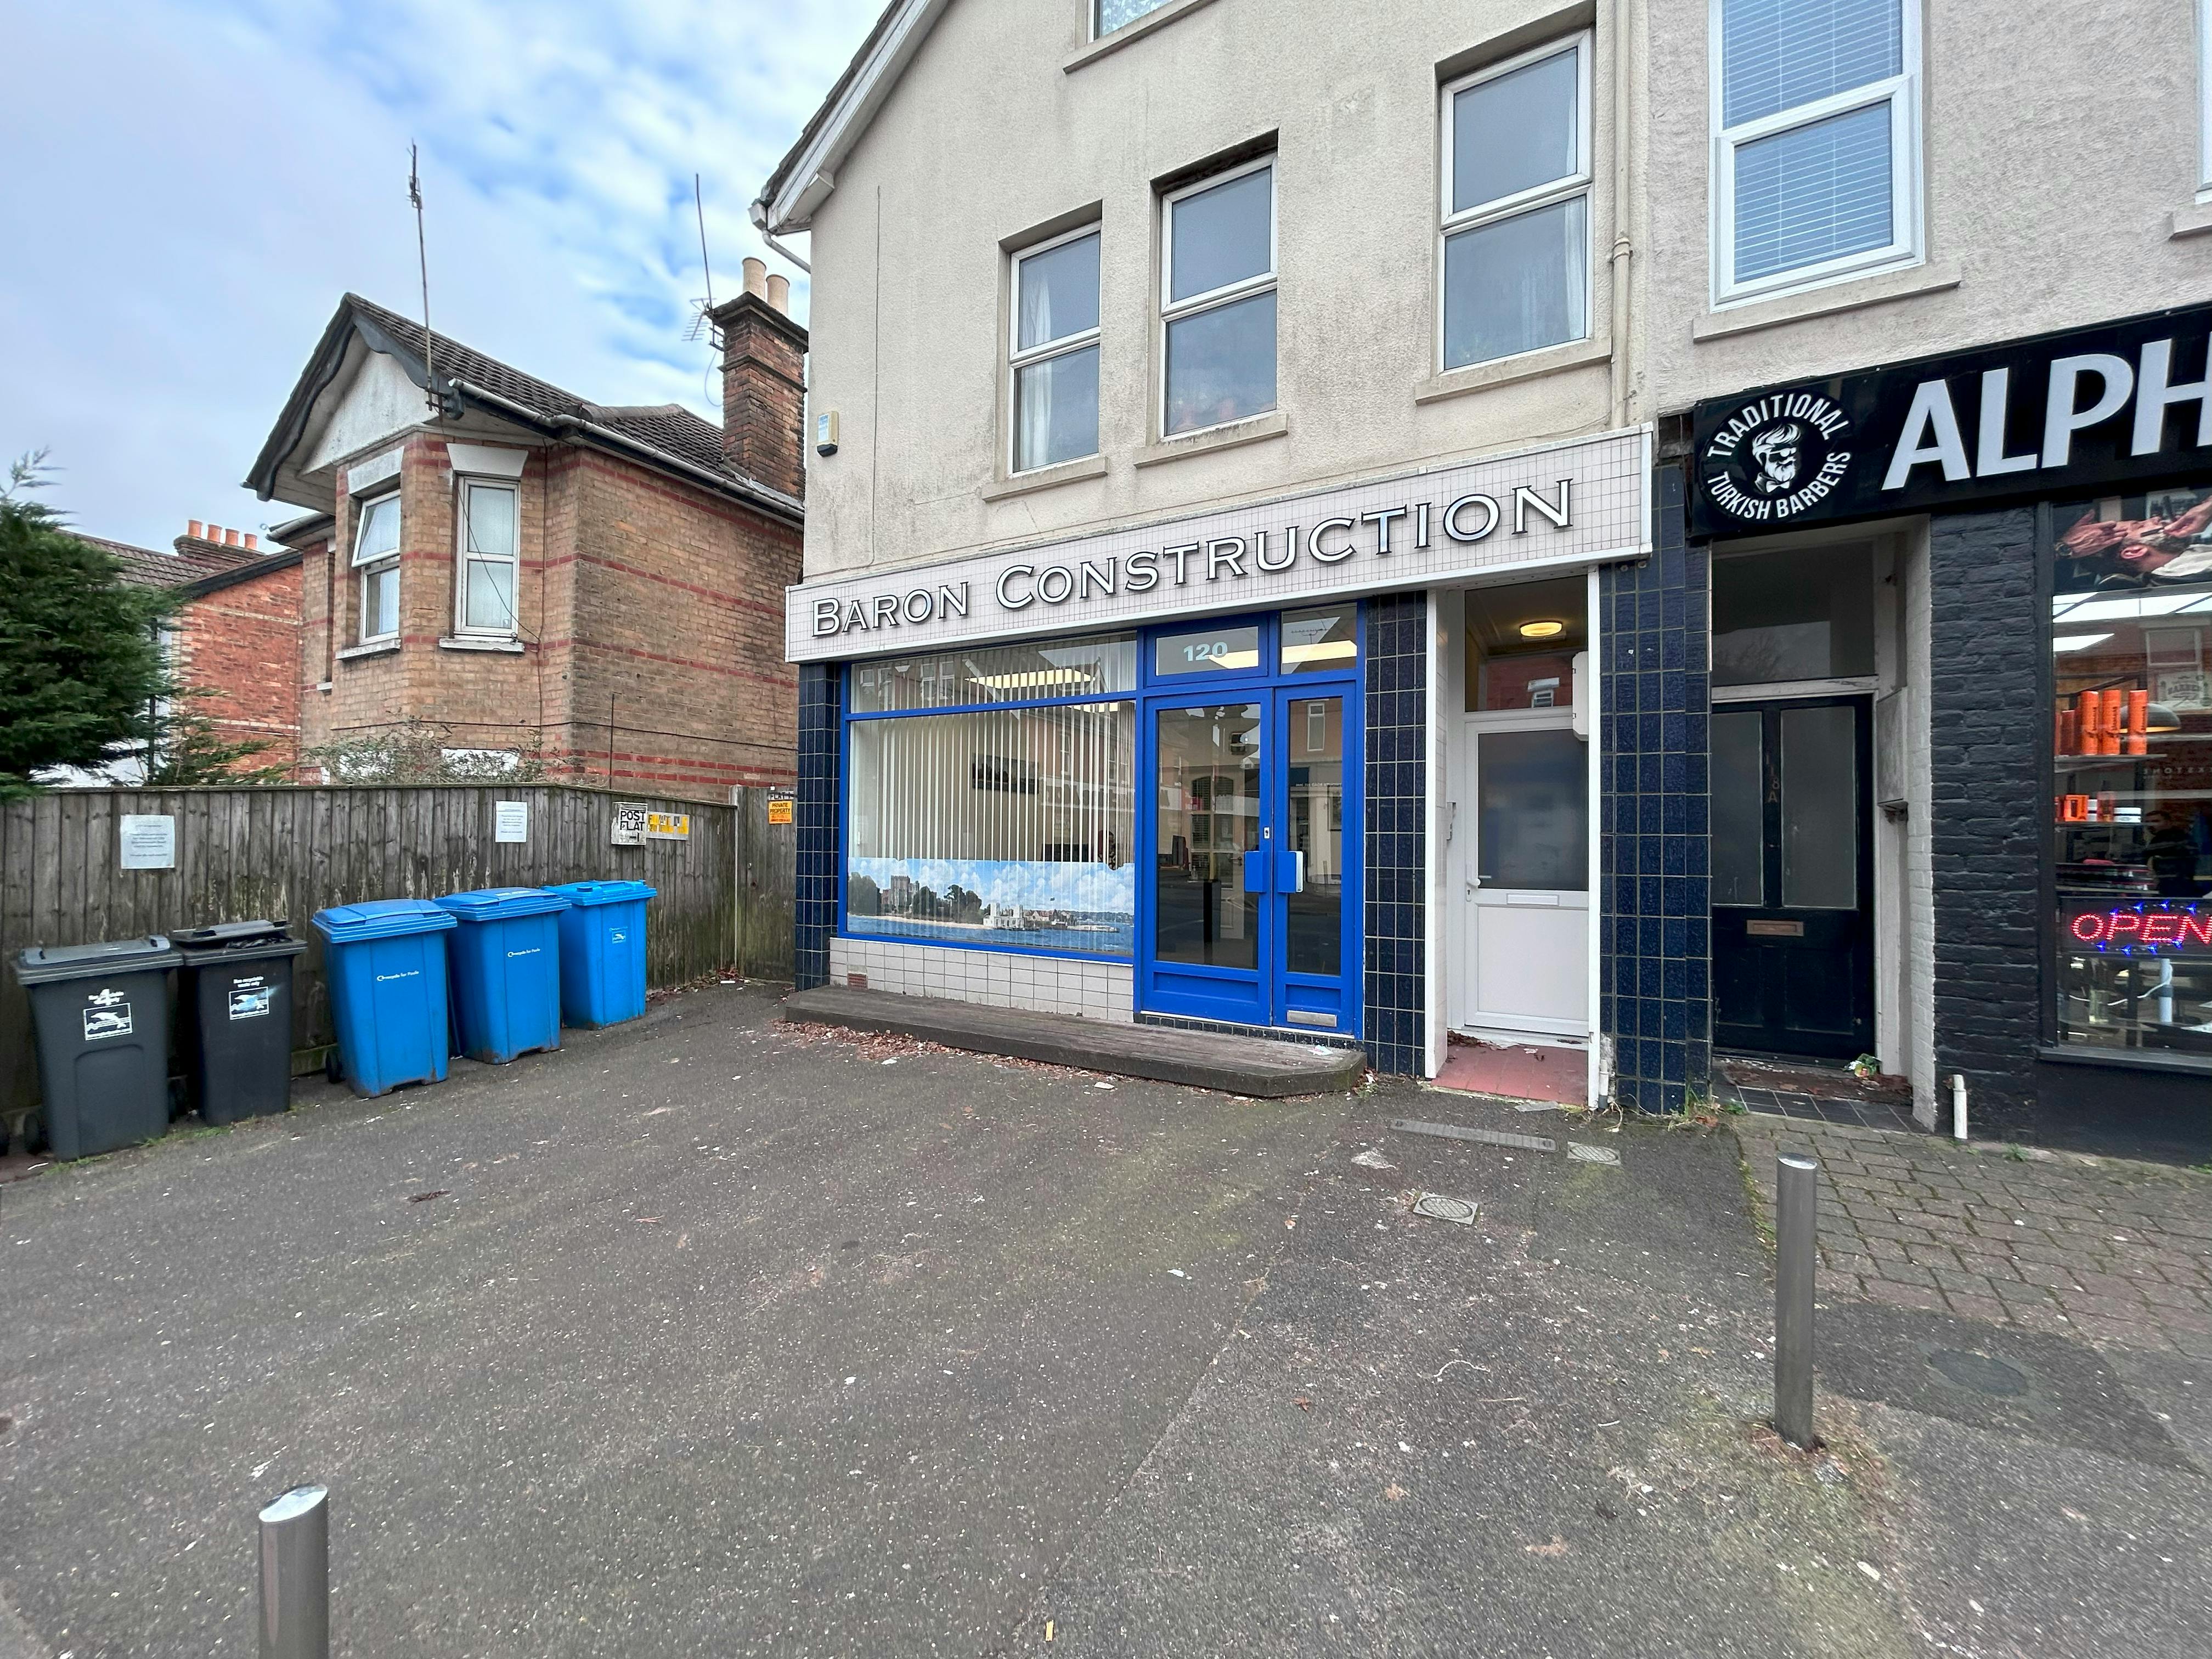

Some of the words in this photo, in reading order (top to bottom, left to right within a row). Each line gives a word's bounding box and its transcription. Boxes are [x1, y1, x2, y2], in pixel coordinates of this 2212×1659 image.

[1707, 394, 1849, 457] TRADITIONAL
[1881, 330, 2212, 490] ALPH
[1707, 471, 1771, 520] TURKISH
[1775, 451, 1852, 518] BARBERS
[811, 580, 969, 637] BARON
[995, 478, 1573, 610] CONSTRUCTION
[1183, 641, 1228, 662] 120
[620, 810, 647, 821] POST
[620, 821, 646, 831] FLAT
[2072, 913, 2212, 944] OPEN
